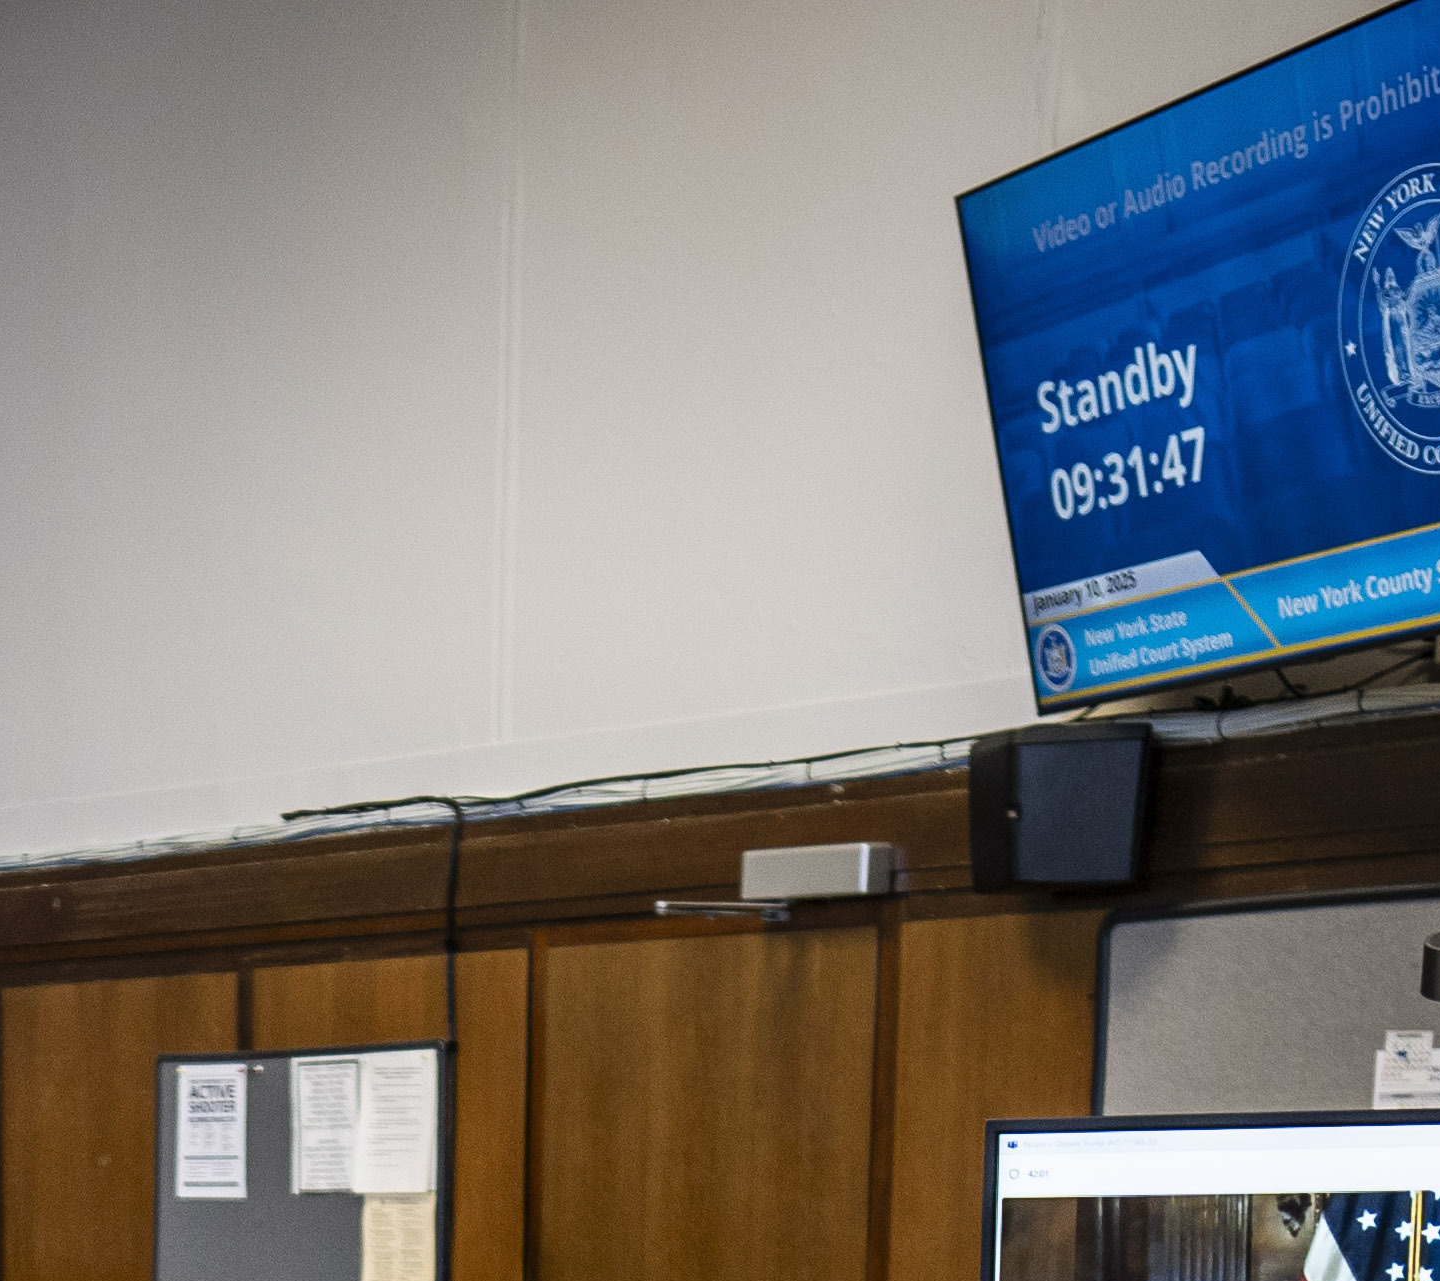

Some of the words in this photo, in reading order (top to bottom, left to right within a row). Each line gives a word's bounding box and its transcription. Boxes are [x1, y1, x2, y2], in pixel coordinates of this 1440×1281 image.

[1032, 211, 1091, 252] Video
[1095, 200, 1118, 229] or
[1123, 171, 1186, 219] Audio
[1191, 122, 1309, 191] Recording
[1313, 110, 1333, 143] is
[1353, 204, 1386, 264] NEW
[1383, 172, 1437, 211] YORK
[1037, 341, 1197, 434] Standby
[1356, 381, 1421, 461] UNIFIED
[1050, 425, 1205, 520] 09:31:47
[1032, 587, 1083, 616] January
[1105, 570, 1137, 594] 2025
[1084, 627, 1115, 647] New
[1116, 616, 1149, 640] York
[1149, 610, 1188, 633] State
[1276, 593, 1318, 619] New
[1320, 579, 1362, 610] York
[1364, 566, 1433, 595] County
[1089, 648, 1139, 677] Unified
[1139, 641, 1180, 666] Court
[1180, 631, 1234, 661] System
